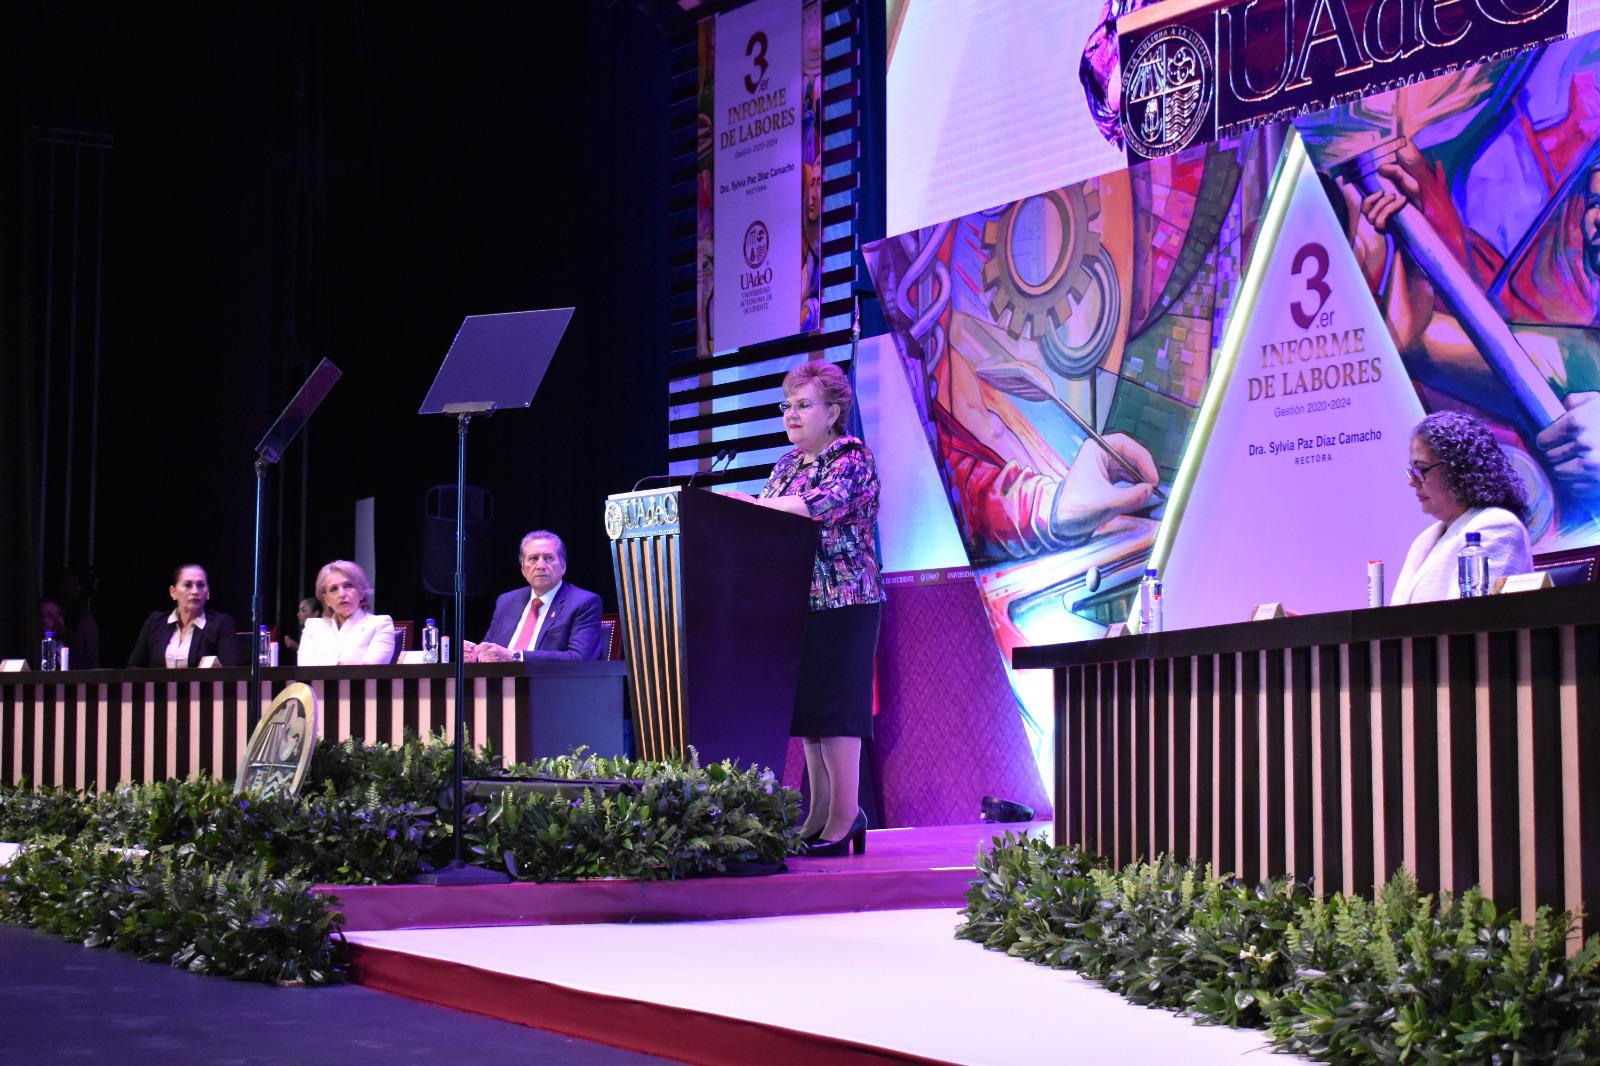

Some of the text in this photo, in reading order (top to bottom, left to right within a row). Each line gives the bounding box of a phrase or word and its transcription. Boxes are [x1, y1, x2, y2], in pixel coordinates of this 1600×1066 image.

[1220, 0, 1563, 102] UAde
[727, 88, 786, 126] INFORME
[720, 107, 796, 150] DE LABORES
[720, 184, 730, 194] Dra.
[770, 163, 795, 178] Camacho
[740, 267, 773, 290] UAdeO
[1261, 327, 1366, 369] INFORME
[1248, 357, 1383, 402] DE LABORES
[1273, 397, 1351, 418] Gestión 2020-2024
[1248, 444, 1267, 456] Dra.
[1269, 439, 1295, 455] Sylvia
[1297, 438, 1314, 450] Paz
[1338, 428, 1382, 445] Camacho
[1294, 453, 1333, 465] RECTORA
